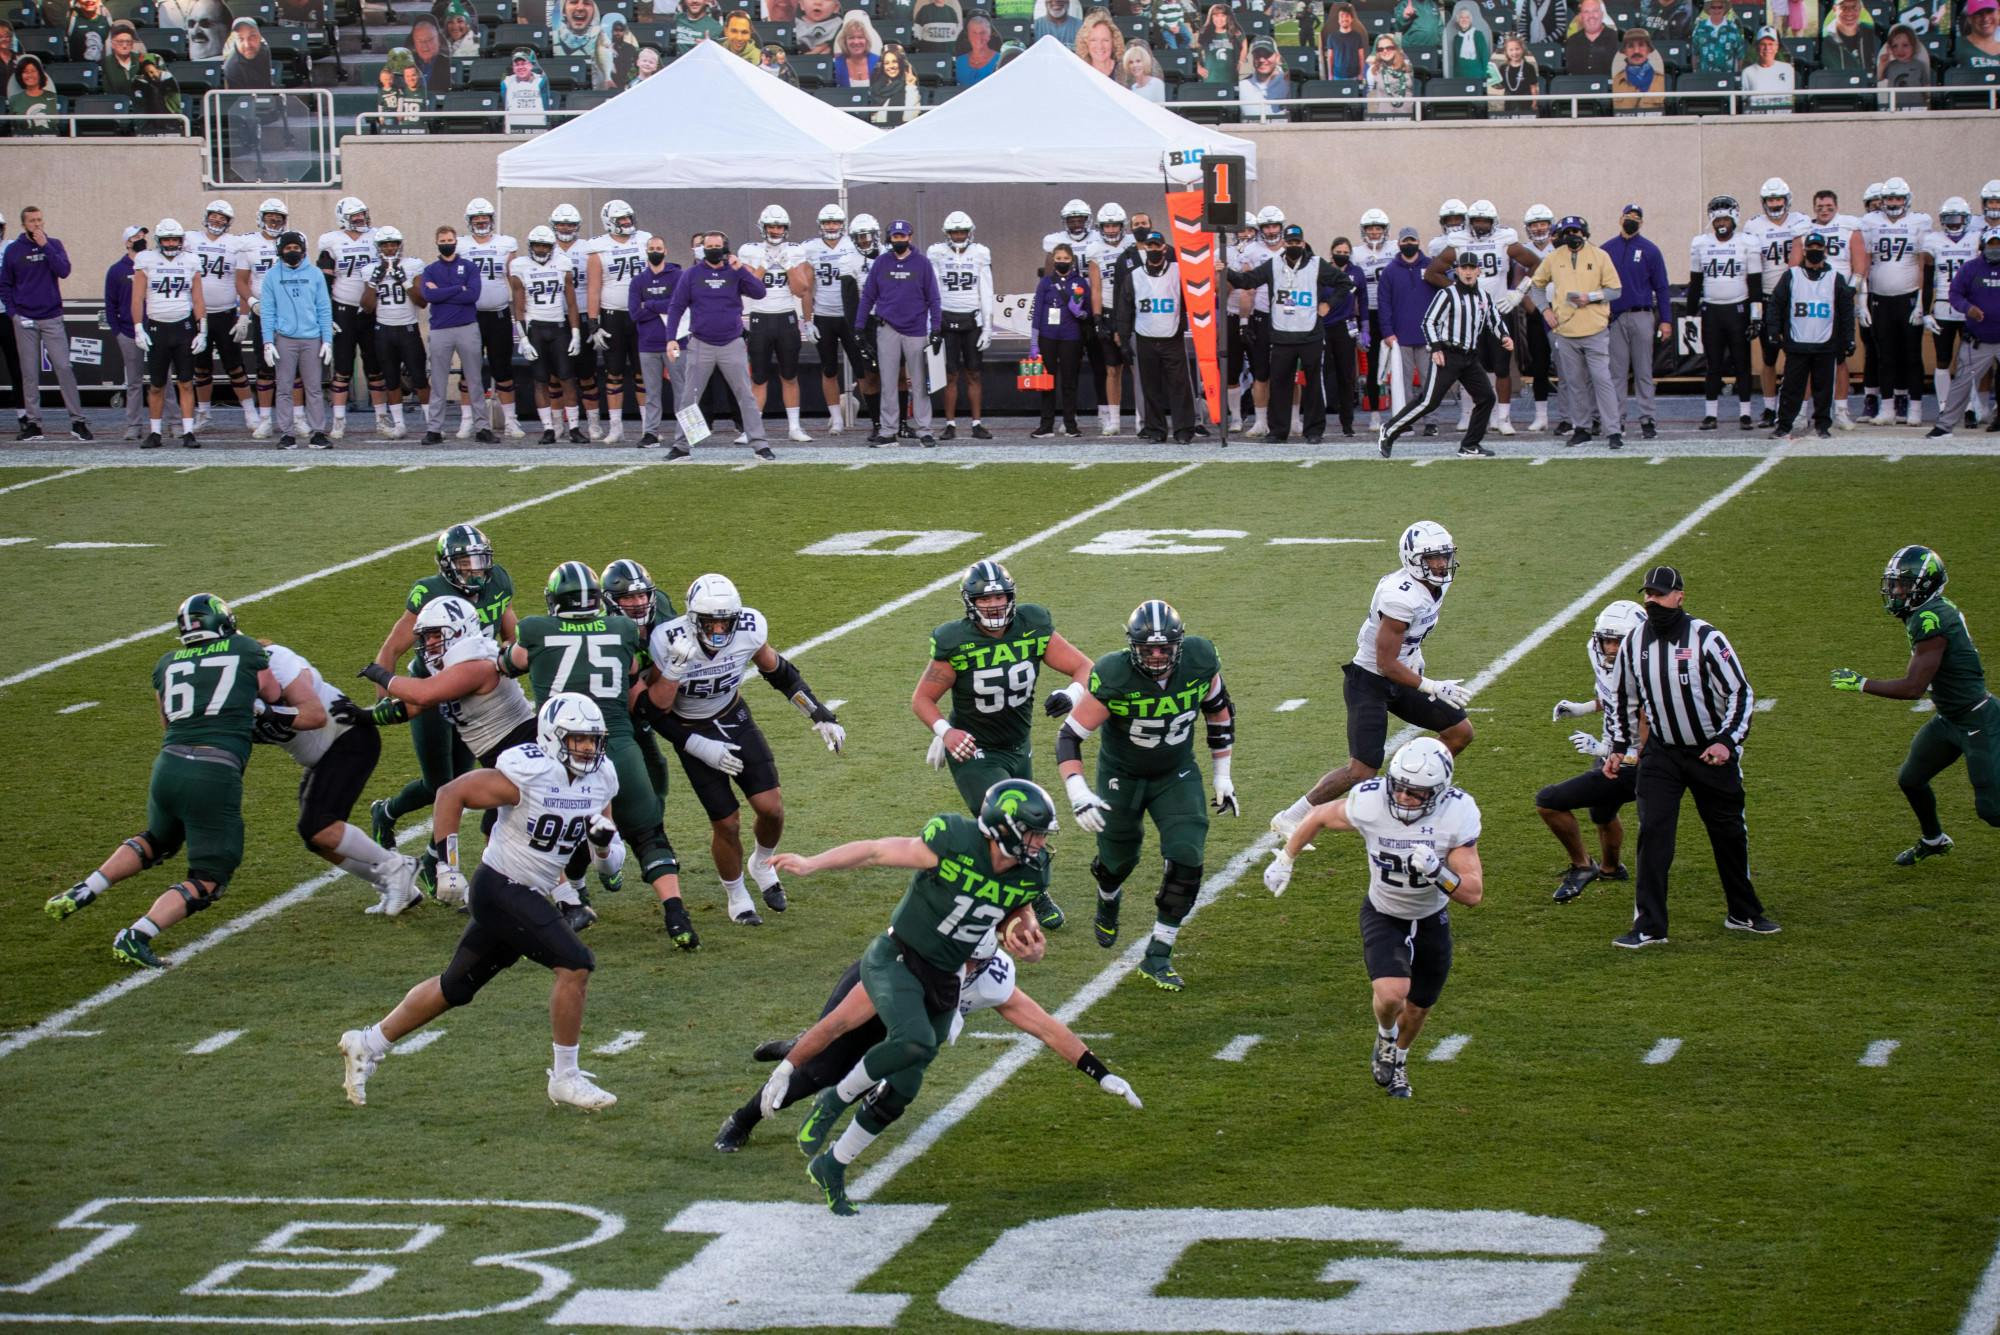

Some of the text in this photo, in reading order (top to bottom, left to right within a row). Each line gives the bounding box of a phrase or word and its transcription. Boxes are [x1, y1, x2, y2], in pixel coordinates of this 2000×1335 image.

[1213, 163, 1231, 203] 1
[1827, 235, 1840, 256] 6
[1879, 238, 1908, 262] 97
[200, 254, 225, 279] 34
[472, 257, 495, 280] 71
[614, 256, 642, 281] 76
[1483, 252, 1498, 278] 9
[1587, 263, 1593, 271] N
[1705, 258, 1736, 279] 44
[157, 276, 186, 299] 47
[532, 280, 560, 305] 27
[946, 271, 974, 292] 22
[377, 282, 406, 305] 20
[1017, 298, 1027, 308] G
[1003, 307, 1013, 318] G
[1139, 298, 1174, 313] B1G
[1794, 302, 1831, 318] B1G
[1024, 378, 1031, 388] G
[1398, 580, 1413, 592] 5
[443, 600, 464, 621] N
[479, 595, 512, 624] ATE
[558, 620, 607, 633] JARVIS
[736, 611, 757, 632] 55
[665, 626, 687, 645] 5
[173, 639, 231, 661] DUPLAIN
[949, 635, 1051, 671] STATE
[1641, 650, 1649, 660] S
[544, 634, 623, 699] 75
[687, 661, 736, 679] NORTHWESTERN
[164, 654, 240, 722] 67
[688, 673, 732, 699] 55
[972, 660, 1036, 714] 59
[1679, 673, 1689, 686] U
[1107, 681, 1210, 718] STATE
[543, 797, 592, 810] NORTHWESTERN
[529, 814, 587, 852] 99
[1379, 850, 1432, 888] 28
[938, 858, 1041, 907] STATE
[937, 895, 1006, 944] 12
[988, 957, 1010, 985] 42
